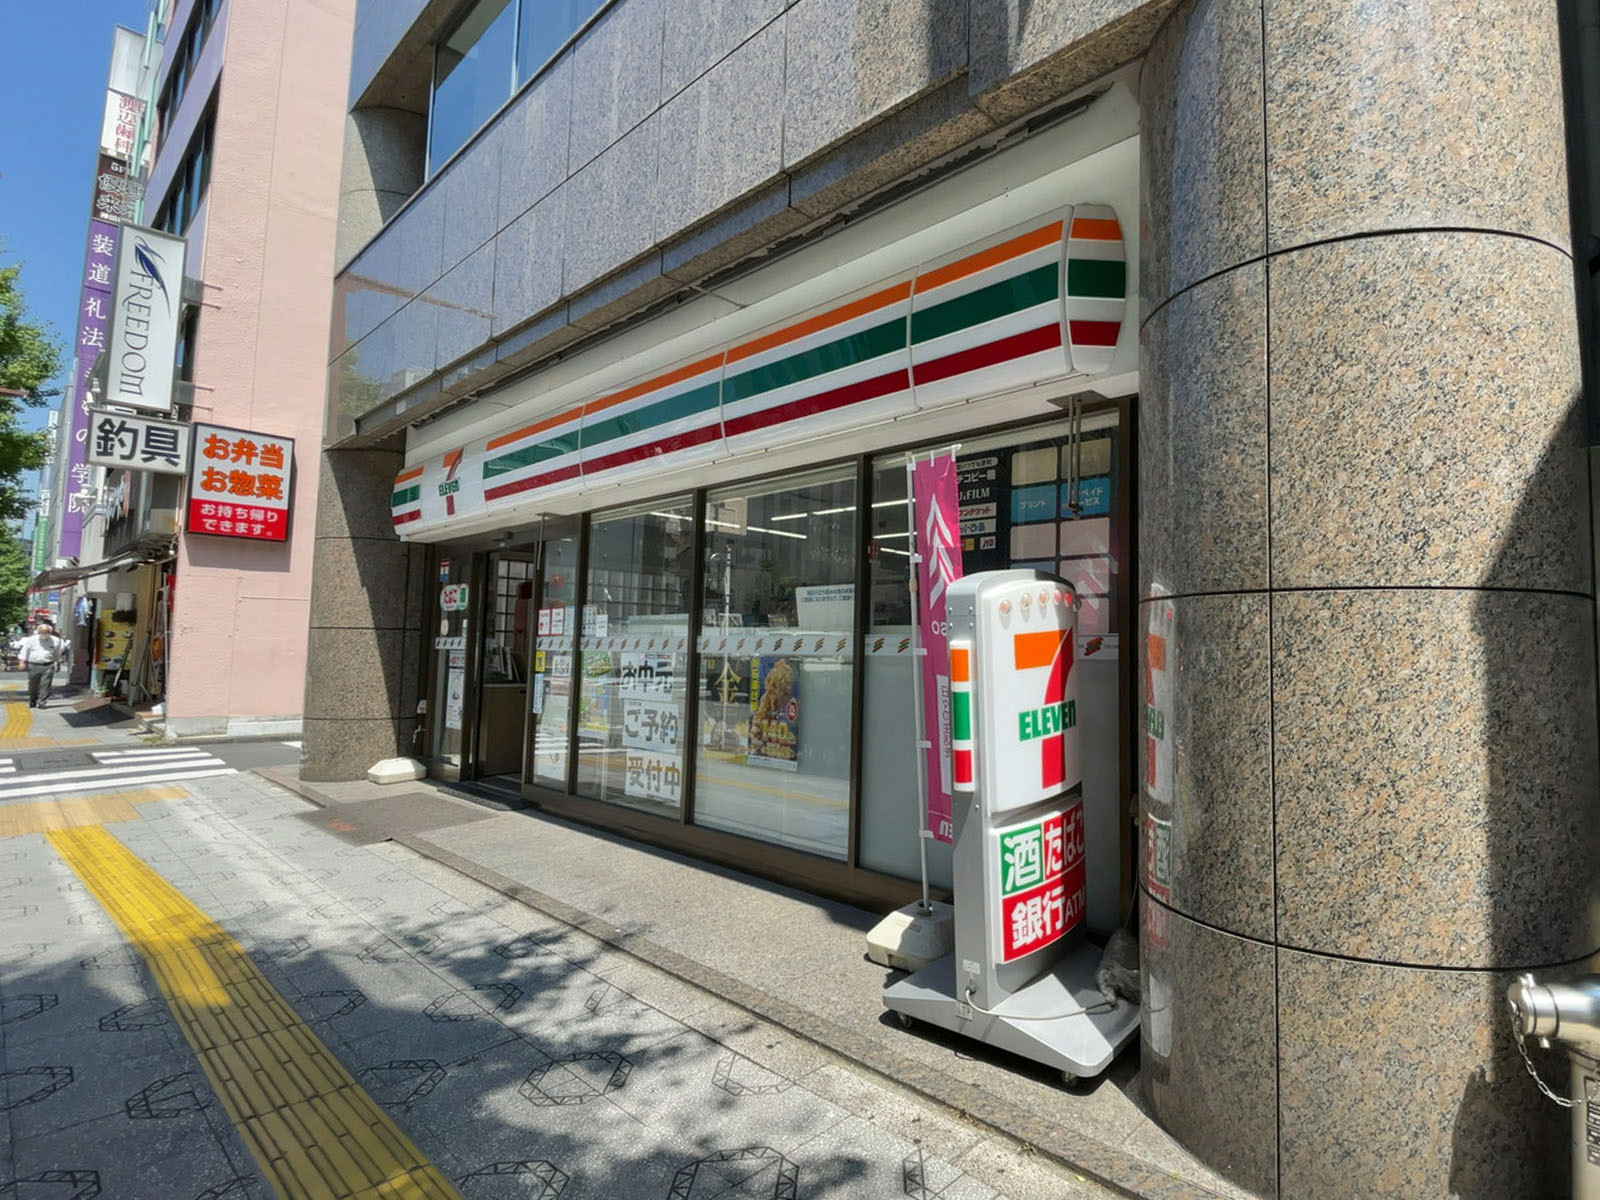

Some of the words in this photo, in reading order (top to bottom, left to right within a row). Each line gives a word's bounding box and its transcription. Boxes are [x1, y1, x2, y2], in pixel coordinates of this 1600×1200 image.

[120, 270, 154, 397] FREEDOM
[95, 417, 182, 468] 釣具
[202, 433, 284, 470] お弁当
[200, 466, 284, 500] お惣菜
[200, 503, 278, 523] お持ち帰り
[202, 518, 273, 536] できます。
[625, 708, 679, 746] ご予約
[628, 756, 681, 797] 受付中
[1003, 828, 1041, 892] 酒
[1045, 808, 1085, 877] たばこ
